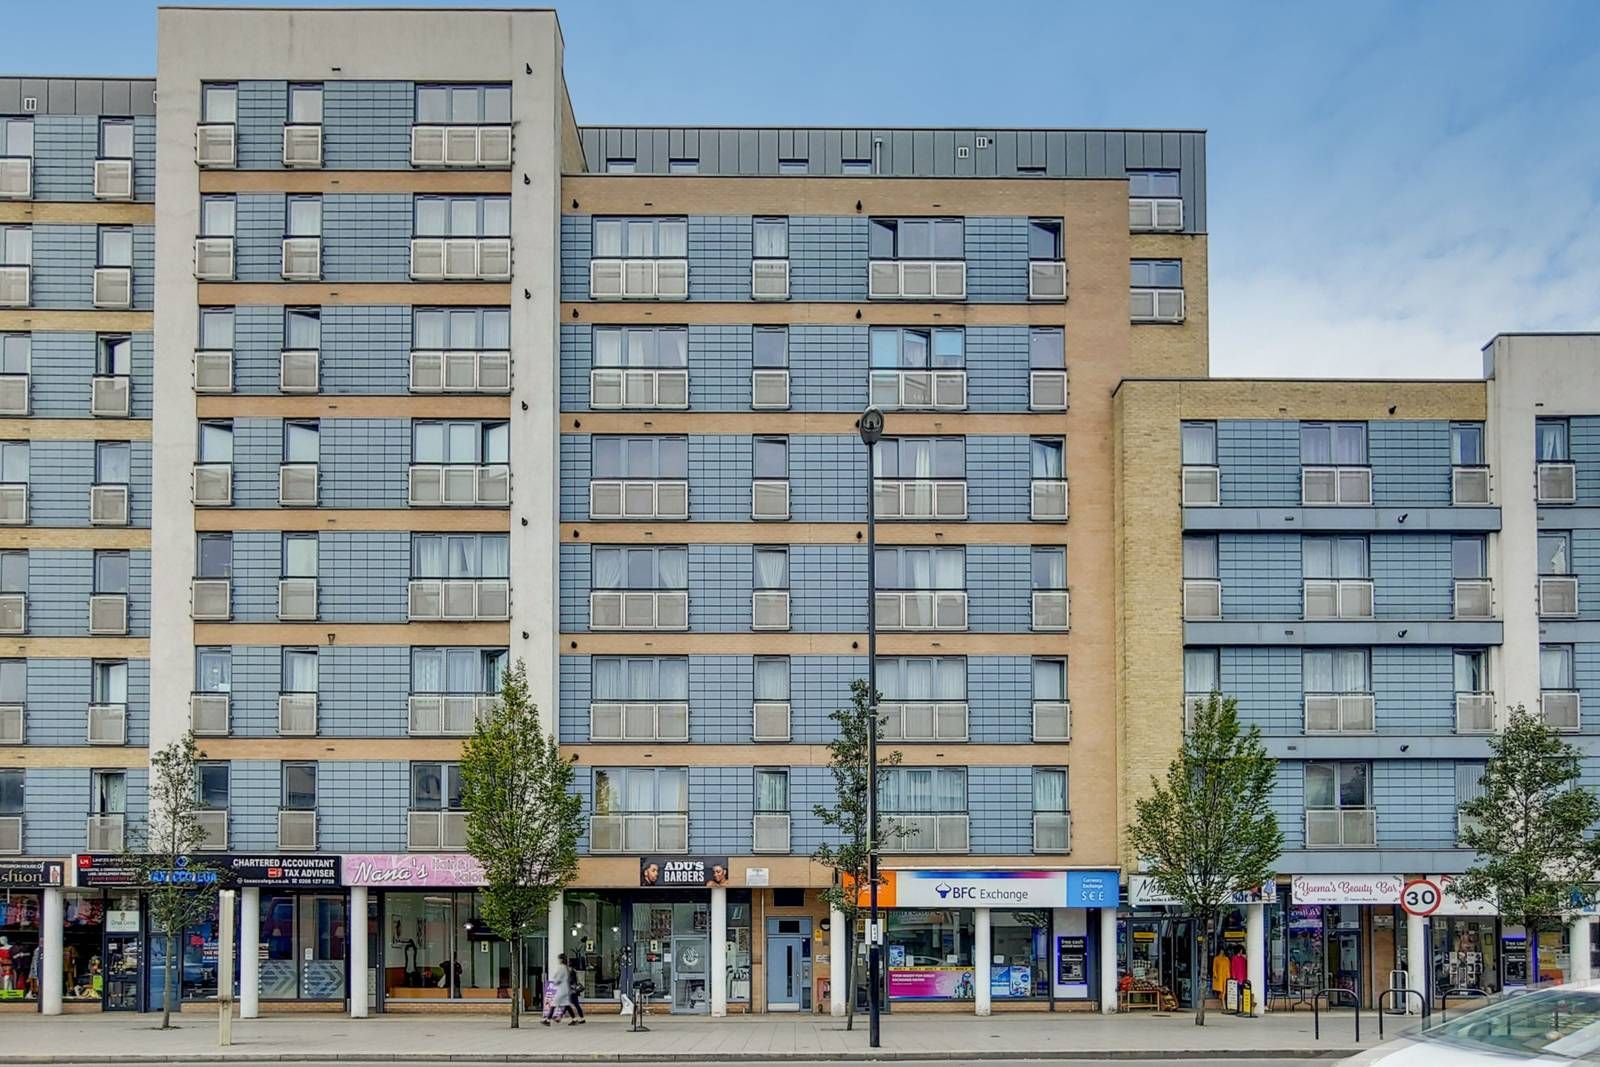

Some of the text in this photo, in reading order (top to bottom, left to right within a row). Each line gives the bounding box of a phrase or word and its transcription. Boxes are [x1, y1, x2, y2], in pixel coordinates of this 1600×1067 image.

[233, 859, 335, 868] CHARTERED ACCOUNTANT
[664, 861, 704, 871] ADU'S
[0, 869, 43, 882] shion
[285, 869, 300, 878] TAX
[301, 869, 335, 878] ADVISER
[353, 857, 428, 884] Nana's
[664, 871, 704, 882] BARBERS
[953, 887, 1029, 902] BFC Exchange
[1338, 881, 1373, 895] Beauty
[1376, 881, 1397, 894] Bar
[1406, 890, 1435, 905] 30
